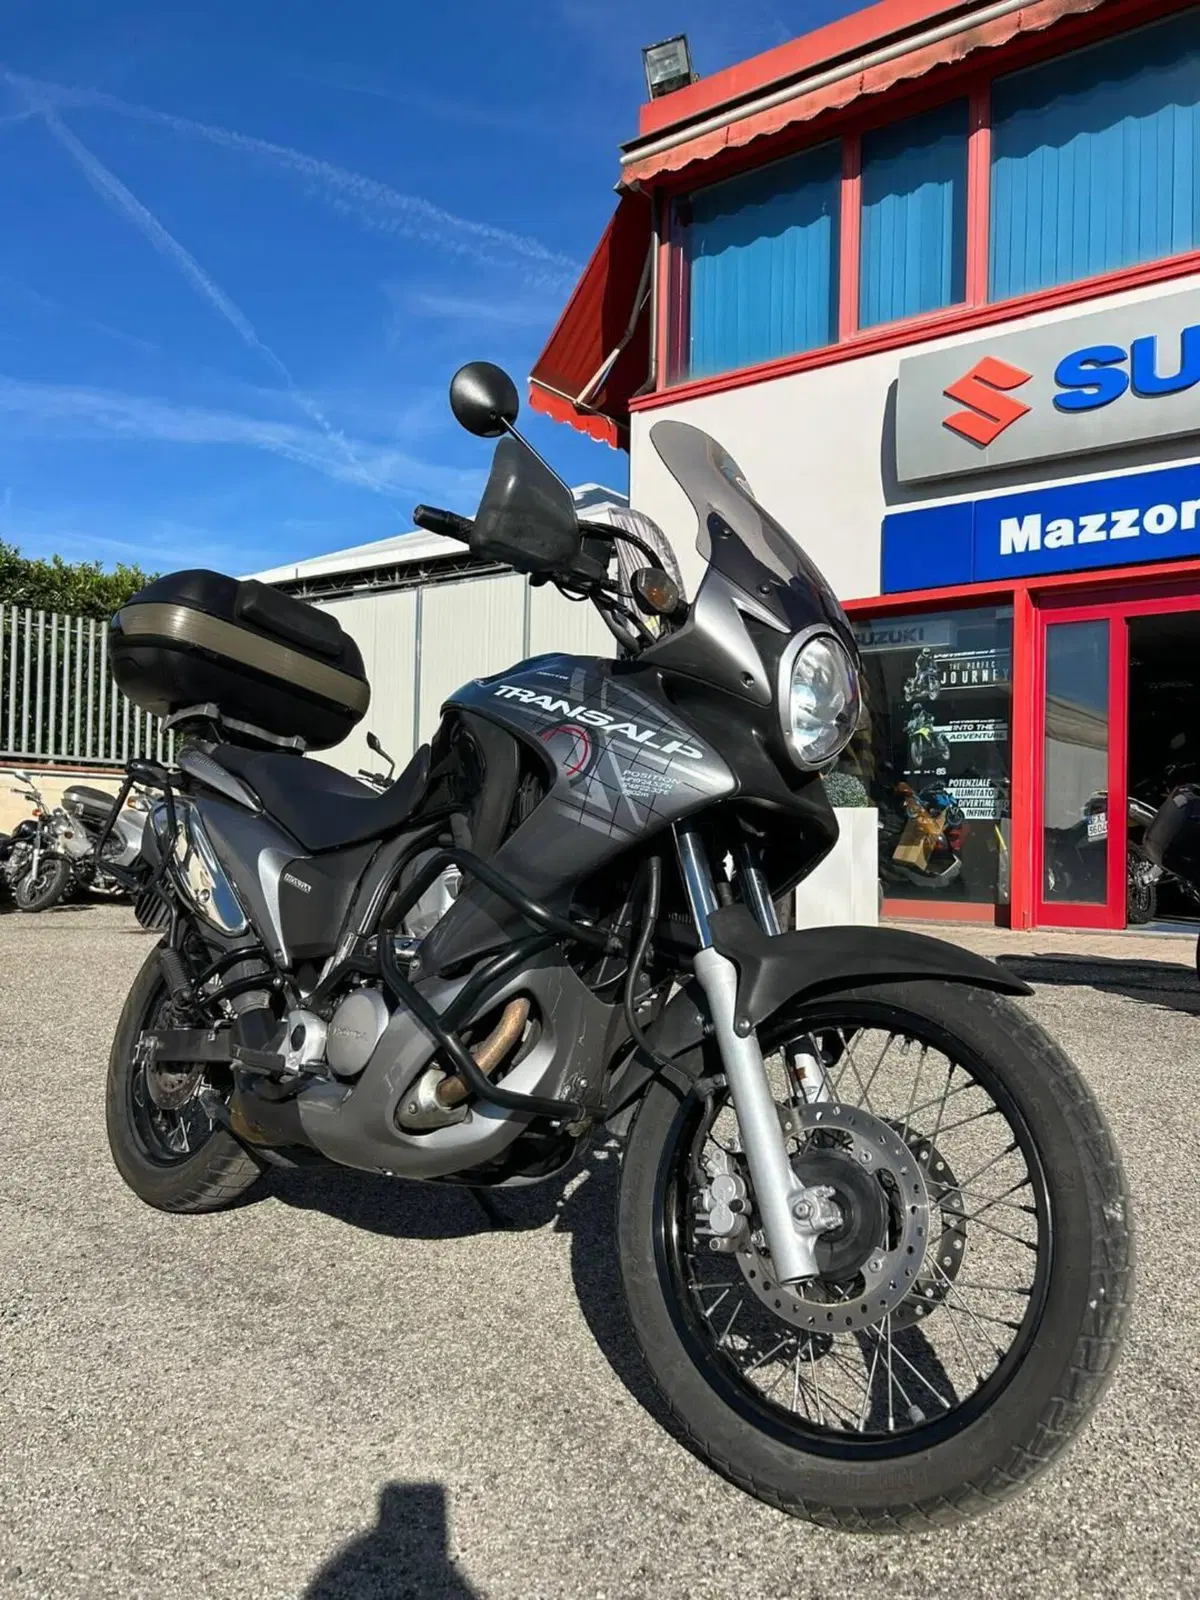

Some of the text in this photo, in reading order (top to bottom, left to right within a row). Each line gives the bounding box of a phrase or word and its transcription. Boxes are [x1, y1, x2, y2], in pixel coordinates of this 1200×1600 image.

[966, 660, 1000, 670] PERFEC
[494, 685, 703, 759] TRANSALP
[976, 723, 995, 731] THE
[949, 731, 1005, 741] ADVENTURE
[948, 778, 992, 788] POTENZIALE
[955, 789, 994, 798] ILLIMITATO
[966, 809, 997, 818] INFINITO
